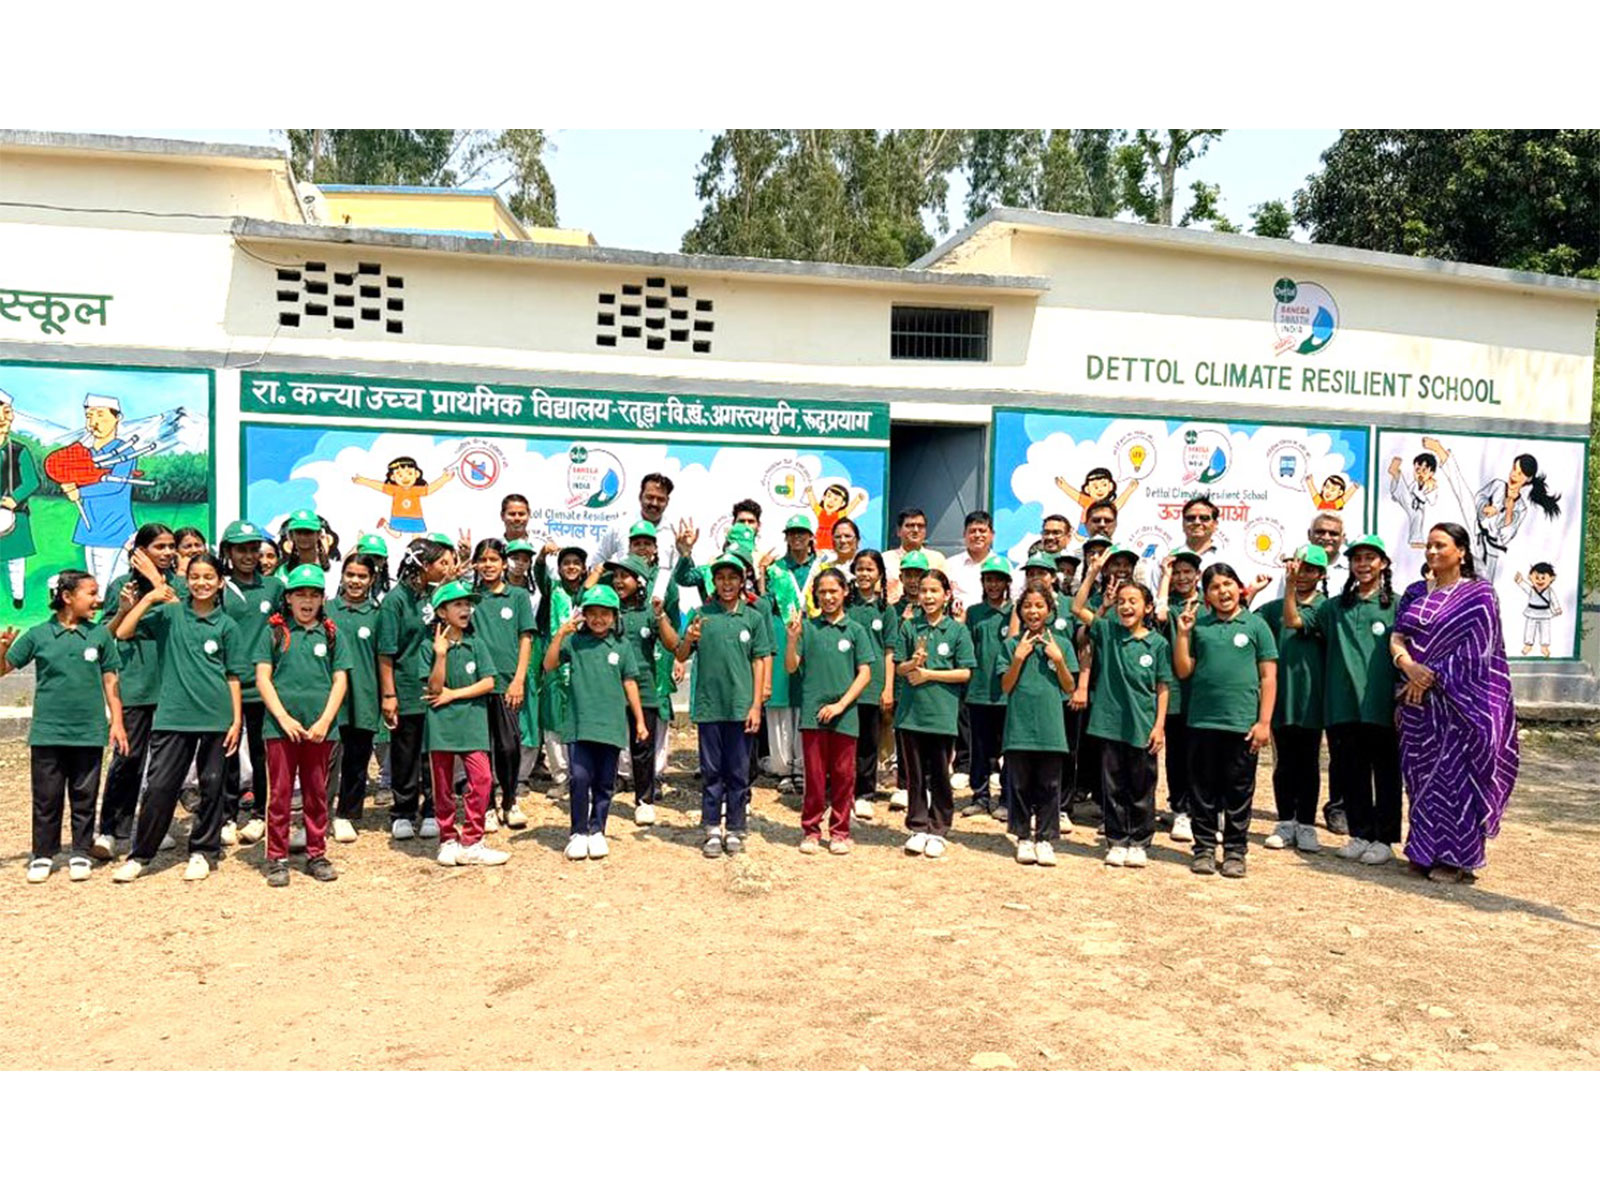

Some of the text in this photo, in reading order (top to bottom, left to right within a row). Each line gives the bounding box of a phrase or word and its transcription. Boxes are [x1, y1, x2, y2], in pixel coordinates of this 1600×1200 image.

[287, 382, 365, 408] कन्या
[366, 387, 427, 412] उच्च
[430, 386, 524, 417] प्राथमिक
[1087, 355, 1501, 405] DETTOL CLIMATE RESILIENT SCHOOL
